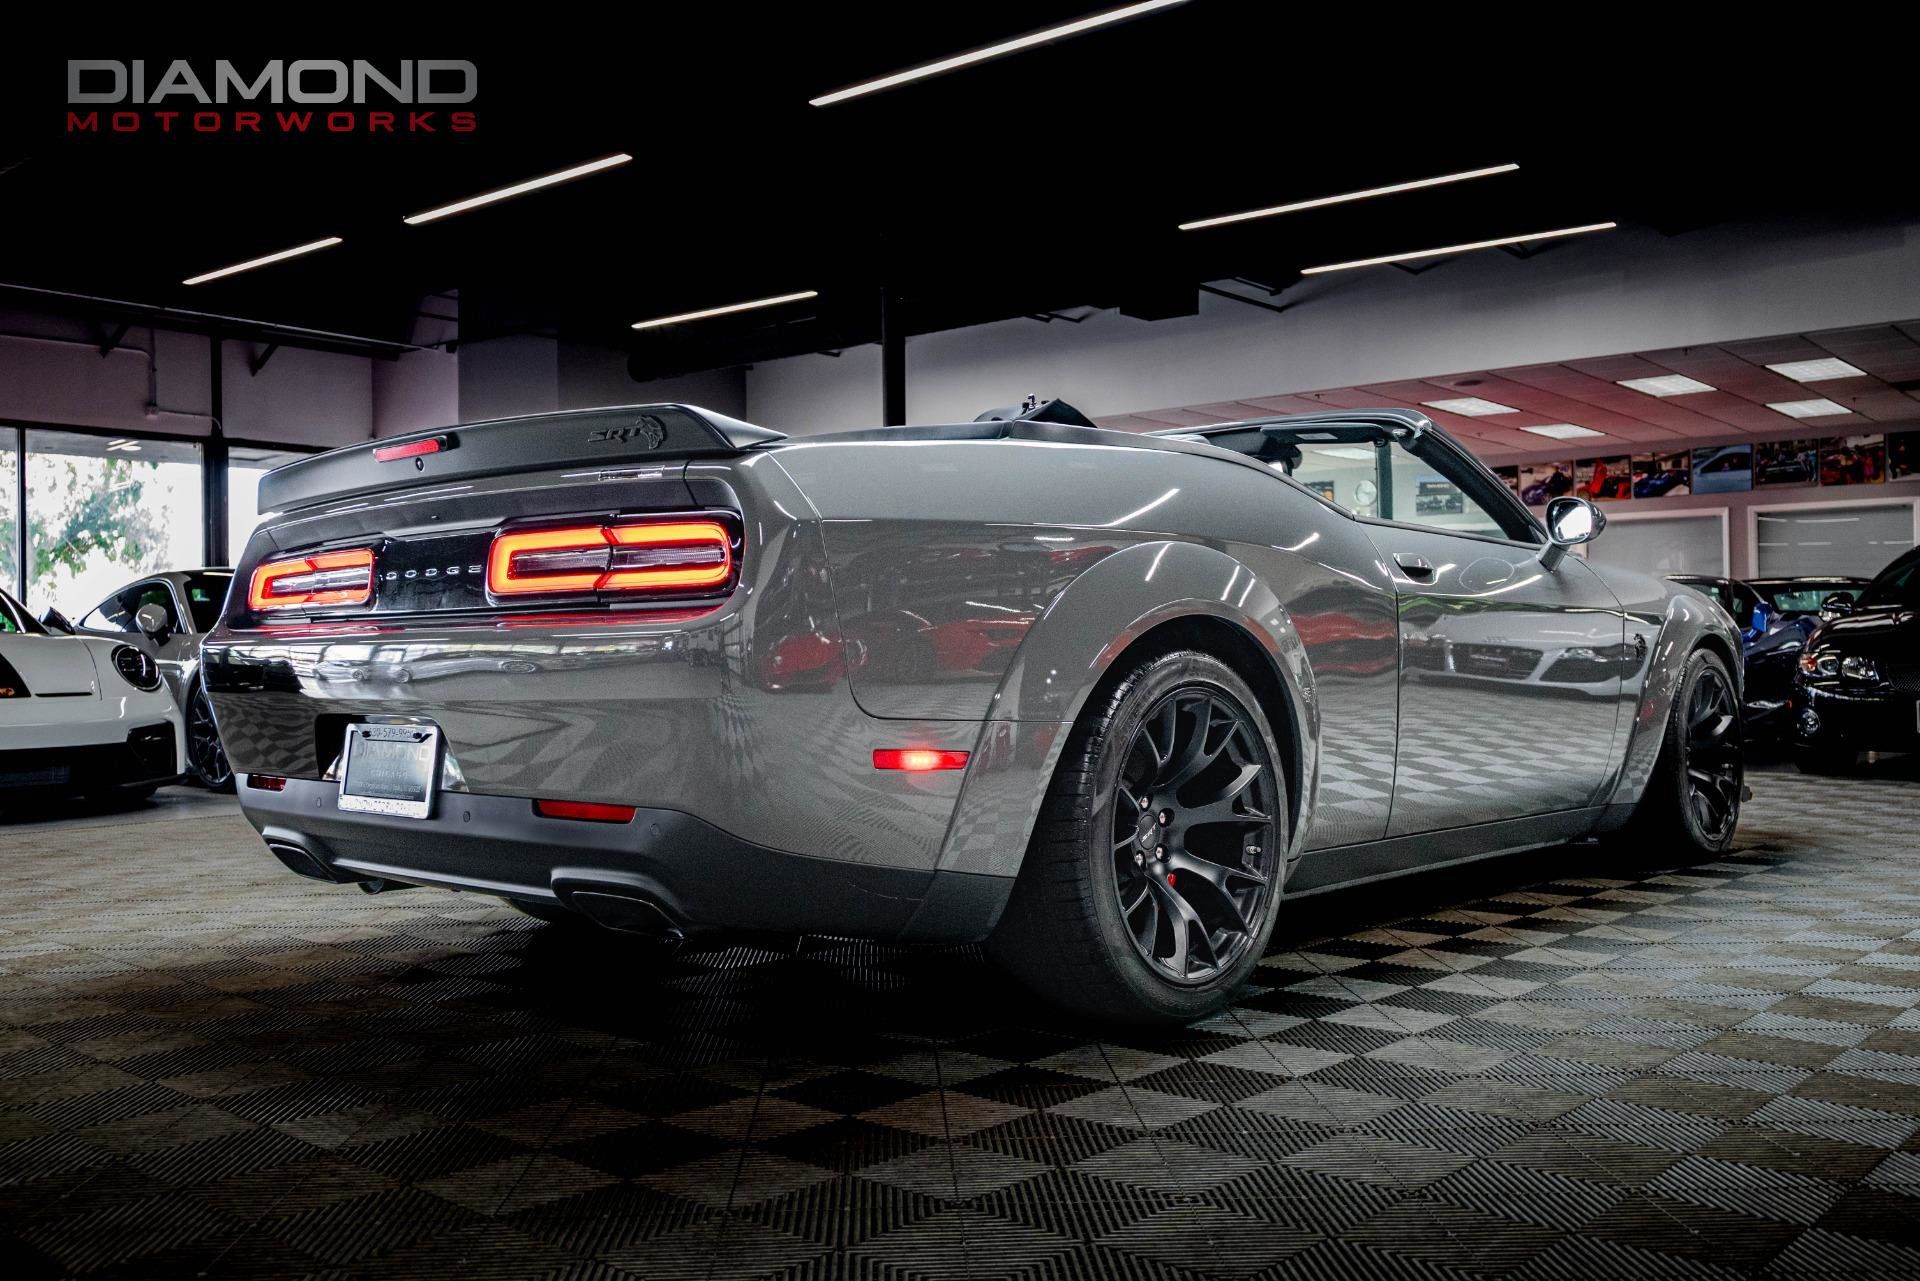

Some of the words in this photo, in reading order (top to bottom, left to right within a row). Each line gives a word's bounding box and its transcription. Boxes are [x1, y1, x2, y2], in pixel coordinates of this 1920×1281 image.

[588, 426, 640, 443] SRT
[386, 565, 482, 580] DODGE
[1141, 822, 1157, 843] SRT
